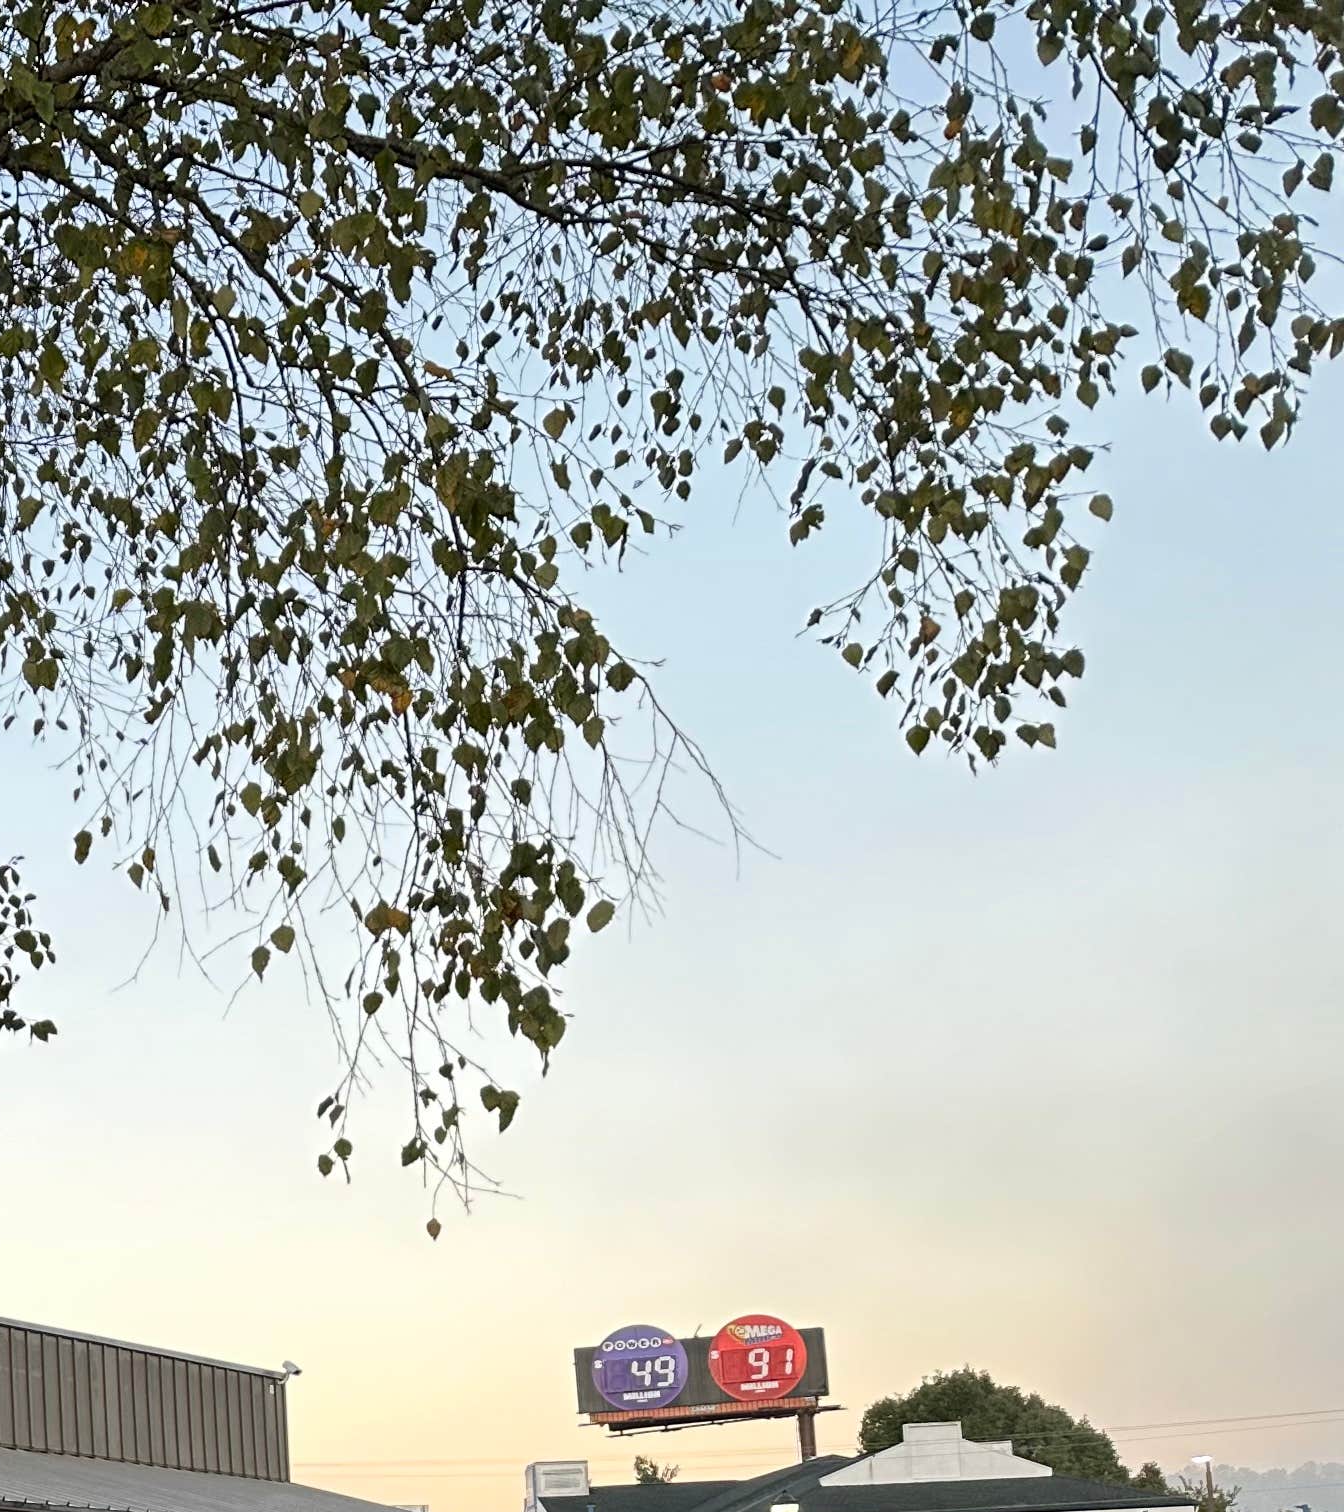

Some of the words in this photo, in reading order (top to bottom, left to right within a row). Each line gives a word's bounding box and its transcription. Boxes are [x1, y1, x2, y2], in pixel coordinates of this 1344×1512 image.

[744, 1325, 783, 1339] MEGA
[631, 1356, 675, 1387] 49
[748, 1347, 794, 1380] 91
